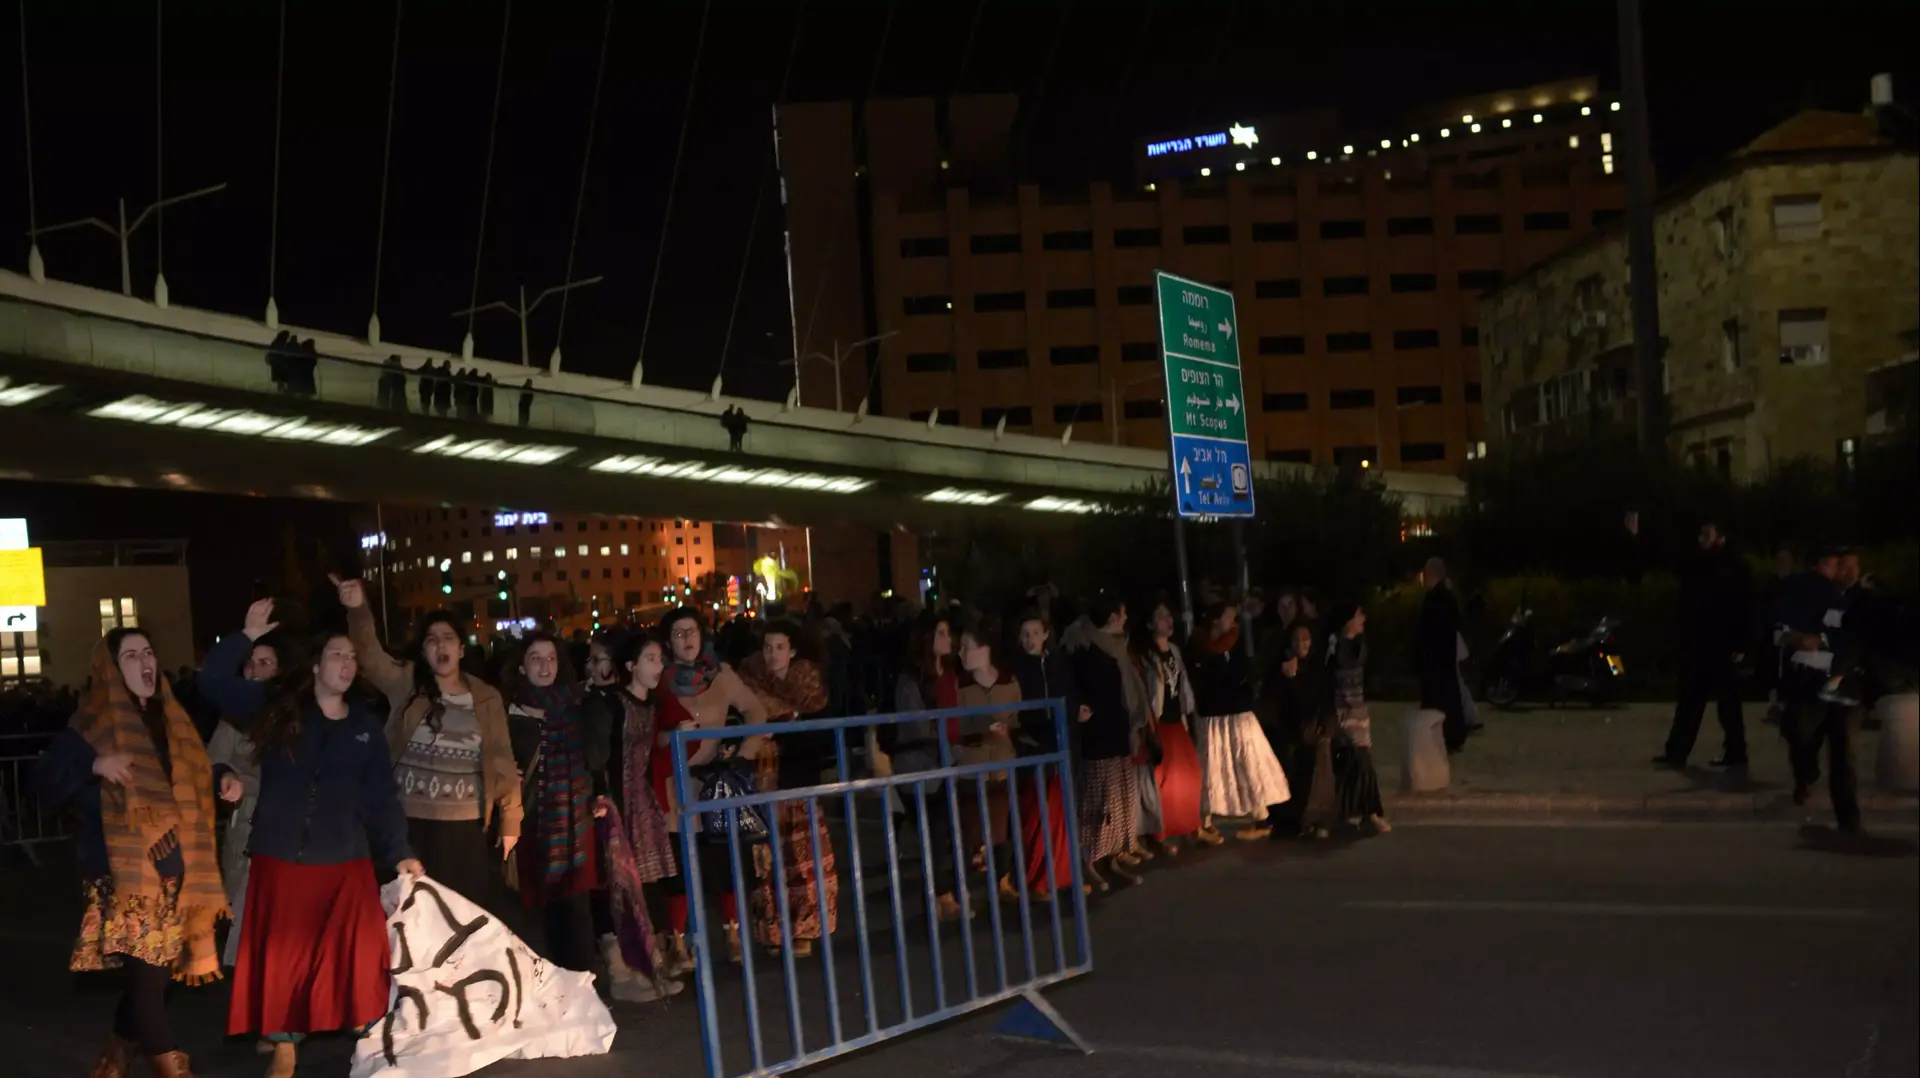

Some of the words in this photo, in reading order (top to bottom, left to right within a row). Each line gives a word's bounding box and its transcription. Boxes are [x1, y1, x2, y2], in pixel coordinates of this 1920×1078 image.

[1147, 138, 1192, 157] הבריאות
[1194, 132, 1227, 149] משרד
[1182, 290, 1209, 309] רוממה
[1183, 333, 1216, 353] Romema
[1181, 367, 1210, 386] הצופים
[1213, 373, 1224, 388] הר
[1186, 411, 1197, 427] Mt
[1200, 413, 1228, 432] Scopus
[1193, 447, 1213, 463] אביב
[1214, 446, 1228, 464] תל
[1198, 490, 1211, 505] Tel
[1213, 492, 1231, 505] Aviv
[522, 511, 548, 525] בית
